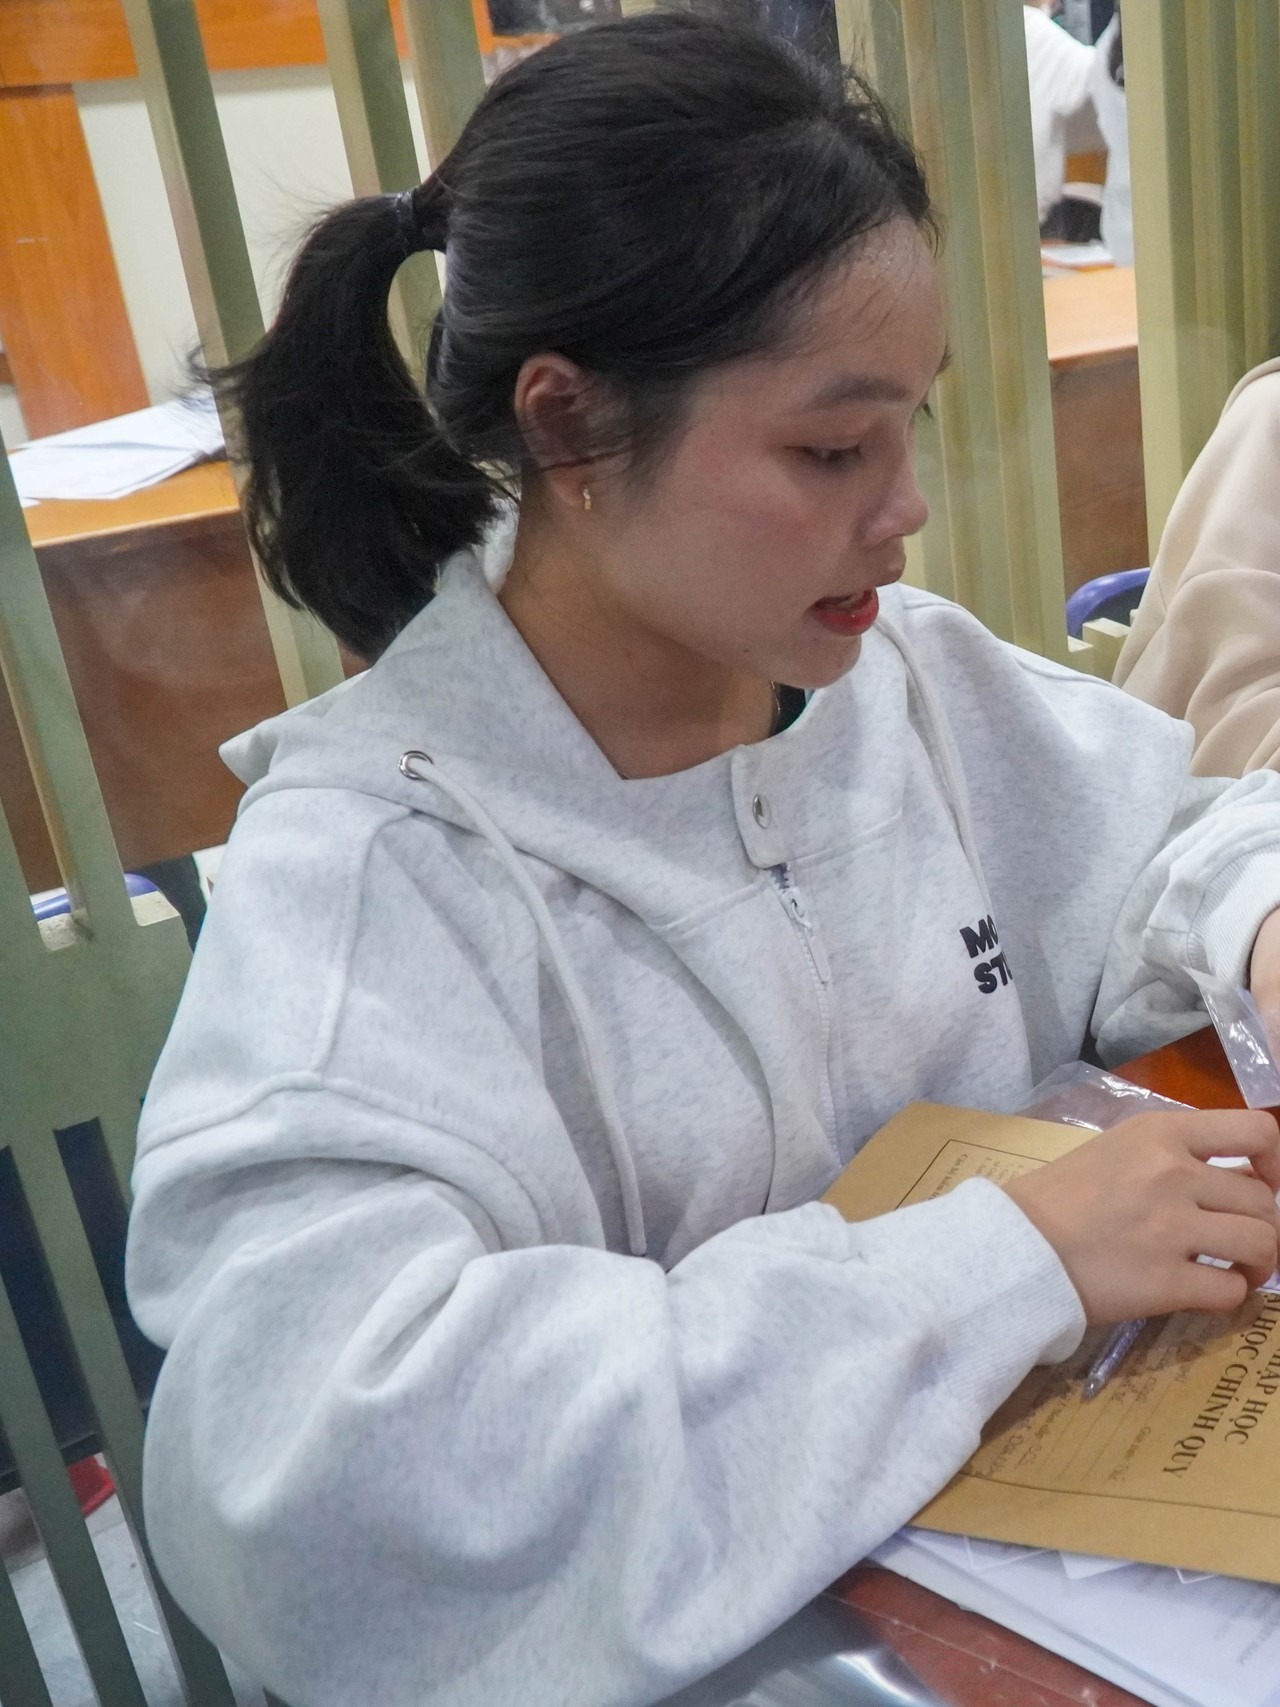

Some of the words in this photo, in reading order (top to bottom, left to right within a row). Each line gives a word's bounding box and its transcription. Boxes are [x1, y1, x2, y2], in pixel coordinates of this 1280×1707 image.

[1236, 1316, 1278, 1360] HỌC
[1193, 1363, 1248, 1431] CHÍNH
[1224, 1398, 1269, 1445] HỌC
[1162, 1435, 1206, 1479] QUY
